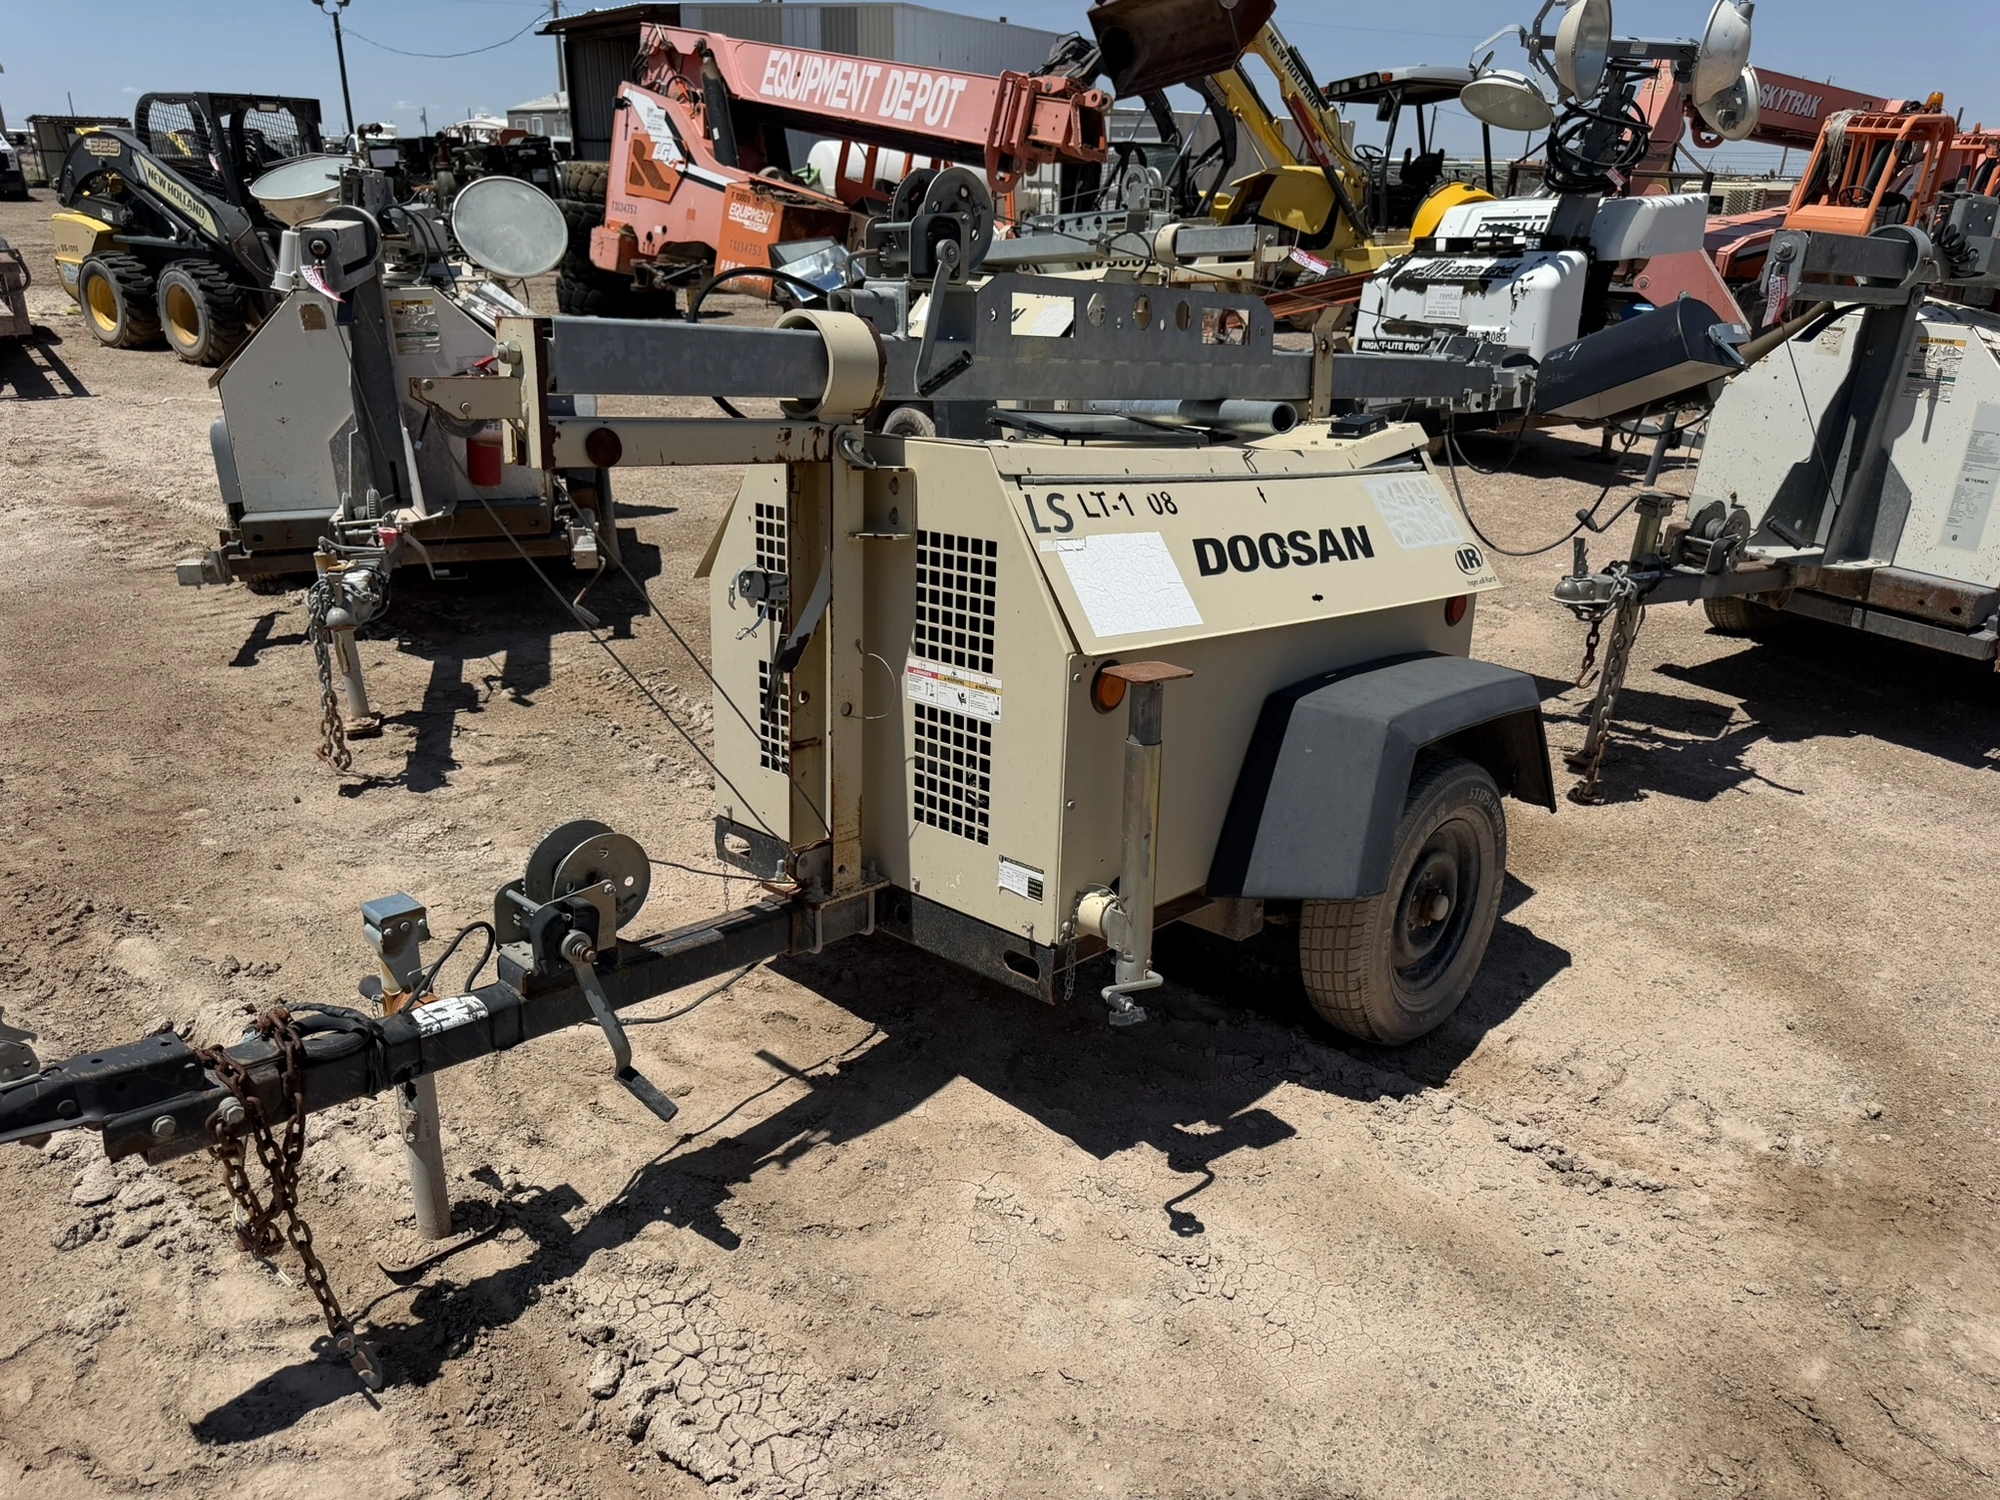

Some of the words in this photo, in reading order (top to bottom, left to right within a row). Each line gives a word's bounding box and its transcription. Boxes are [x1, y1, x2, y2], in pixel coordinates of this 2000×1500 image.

[759, 50, 882, 113] EQUIPMENT
[878, 69, 968, 129] DEPOT
[1267, 33, 1288, 60] NEW
[1284, 57, 1319, 109] HOLLAND
[1759, 83, 1824, 119] SKYTRAK
[147, 168, 167, 190] NEW
[167, 182, 206, 219] HOLLAND
[728, 202, 775, 225] EQUIPMENT
[1404, 343, 1420, 352] PRO
[1024, 492, 1074, 534] LS
[1192, 525, 1375, 577] DOOSAN
